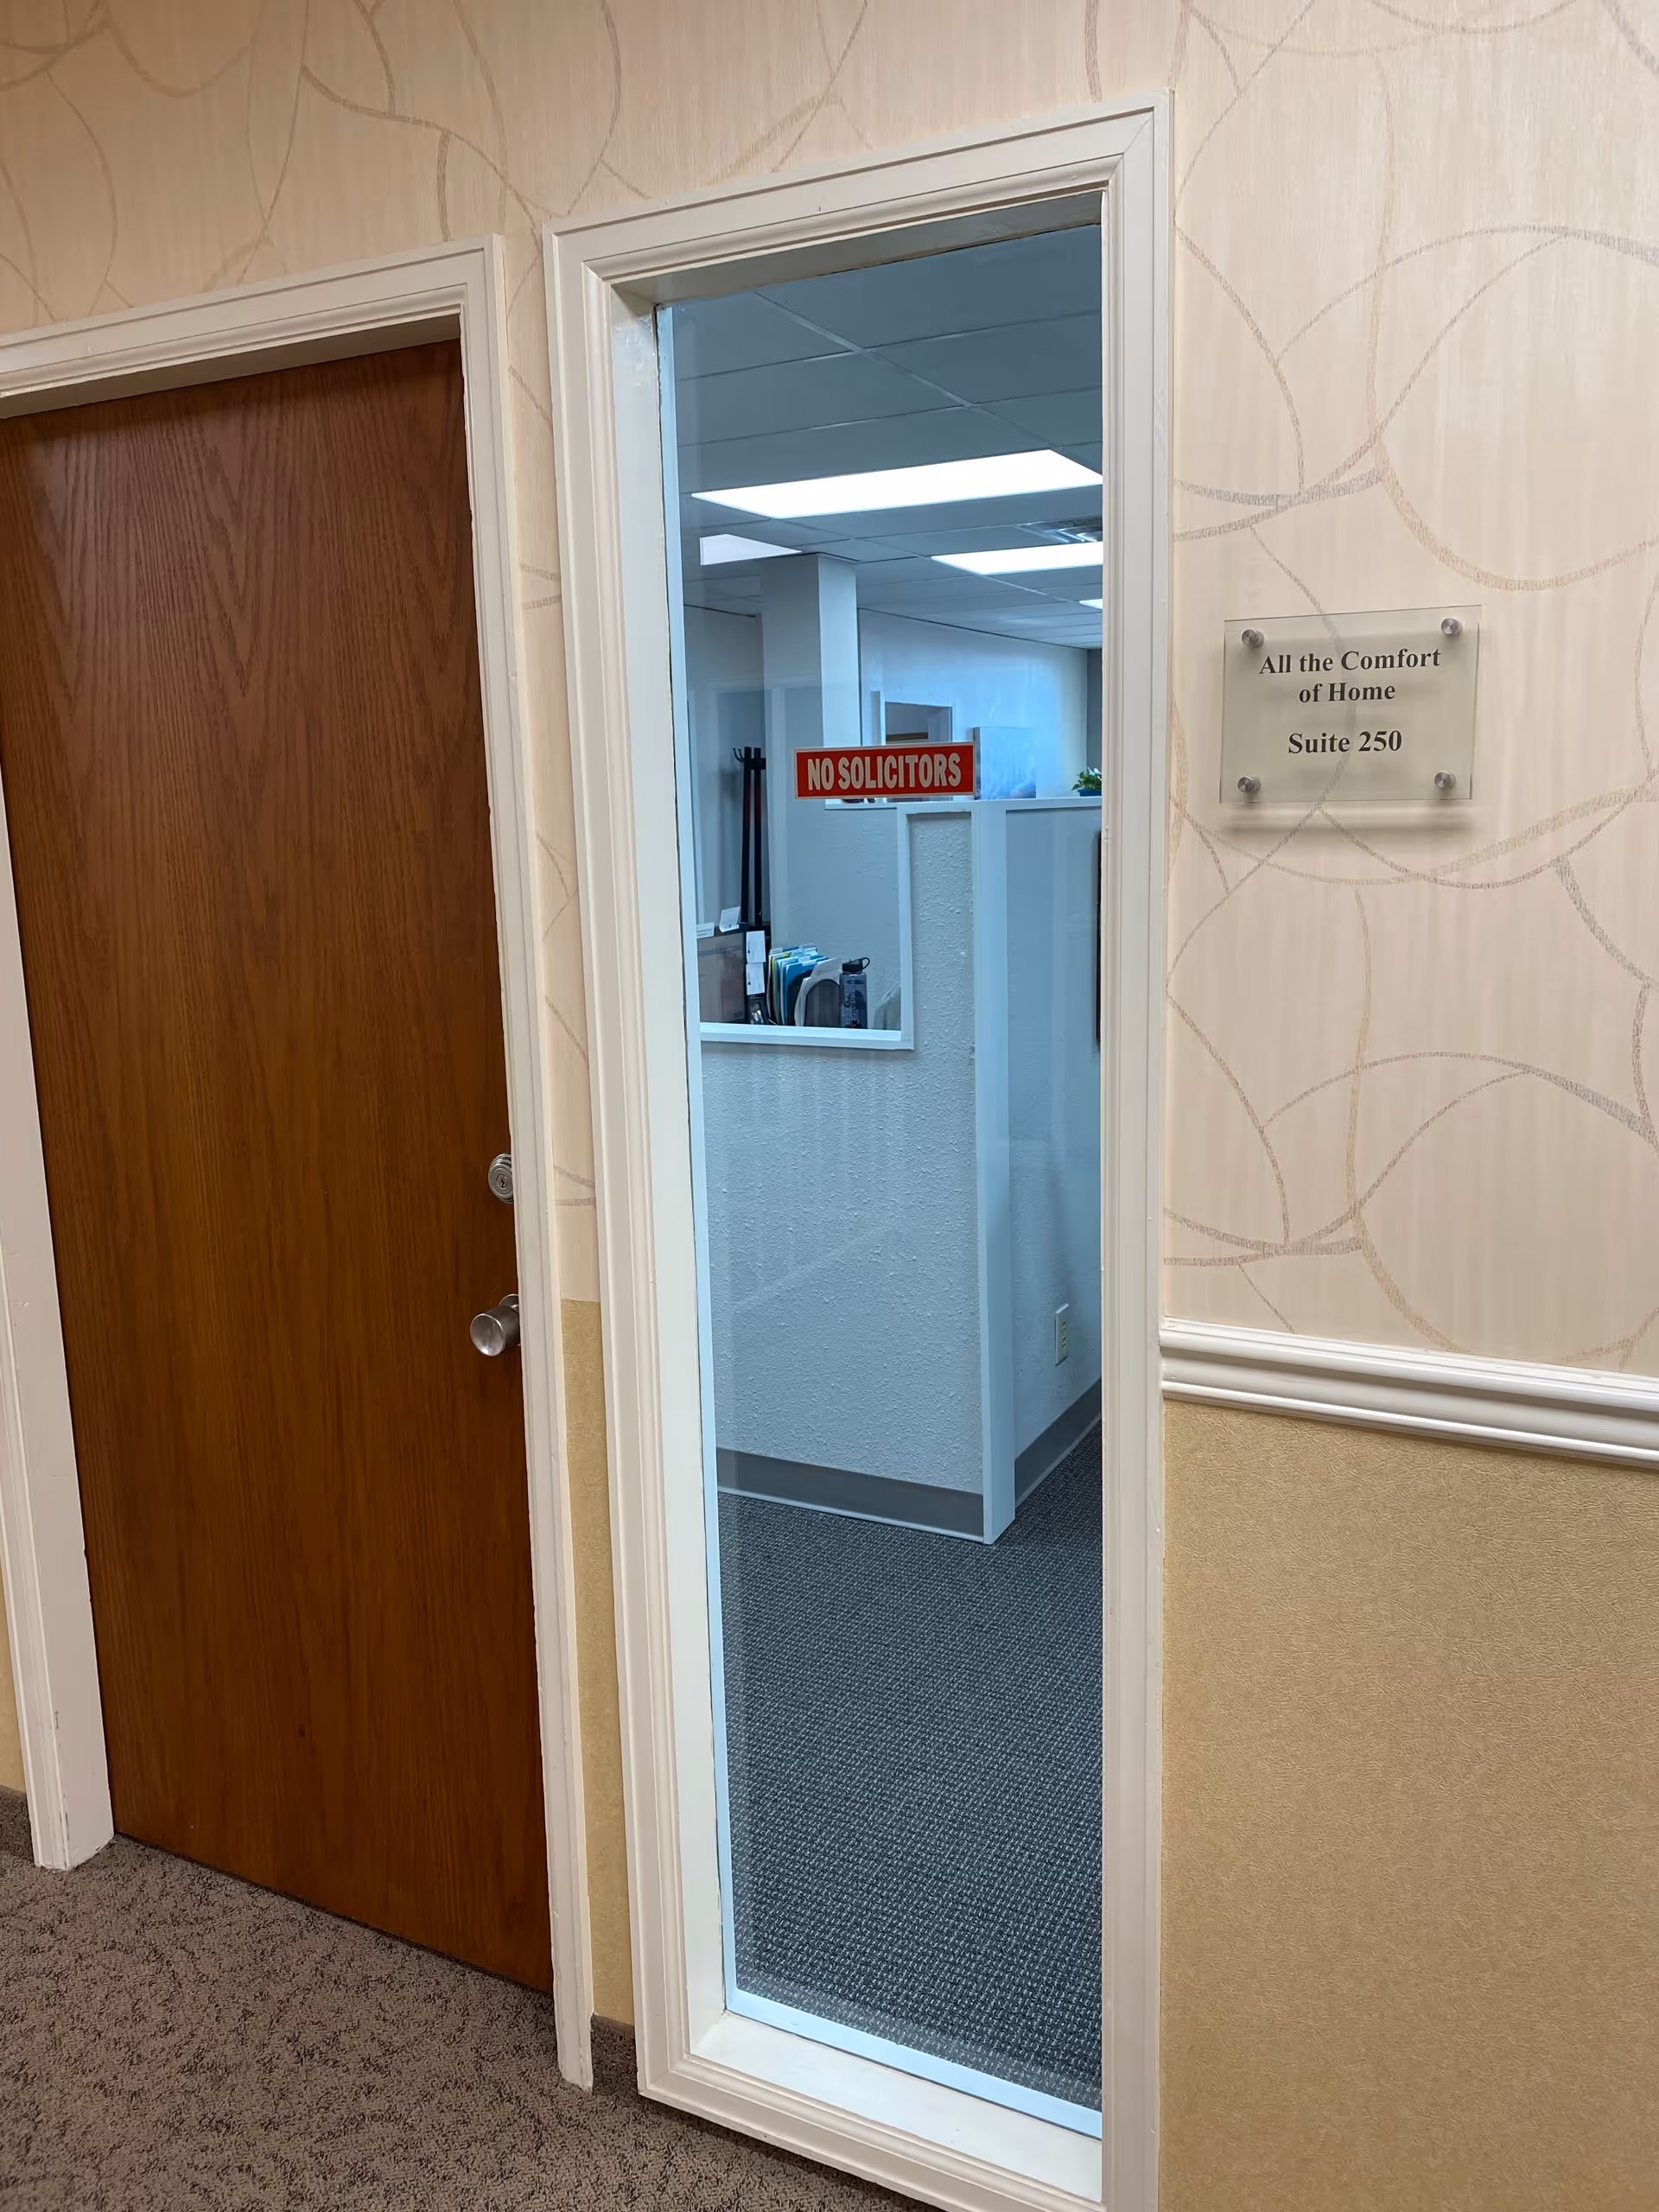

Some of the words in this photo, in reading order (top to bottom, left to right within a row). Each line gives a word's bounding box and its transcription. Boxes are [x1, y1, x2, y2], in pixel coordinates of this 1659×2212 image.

[1259, 655, 1292, 674] All
[1300, 654, 1333, 672] the
[1341, 648, 1441, 671] Comfort
[1299, 683, 1323, 703] of
[1327, 682, 1395, 702] Home
[1288, 733, 1351, 754] Suite
[1358, 730, 1402, 752] 250
[807, 758, 835, 791] NO
[838, 753, 962, 790] SOLICITORS
